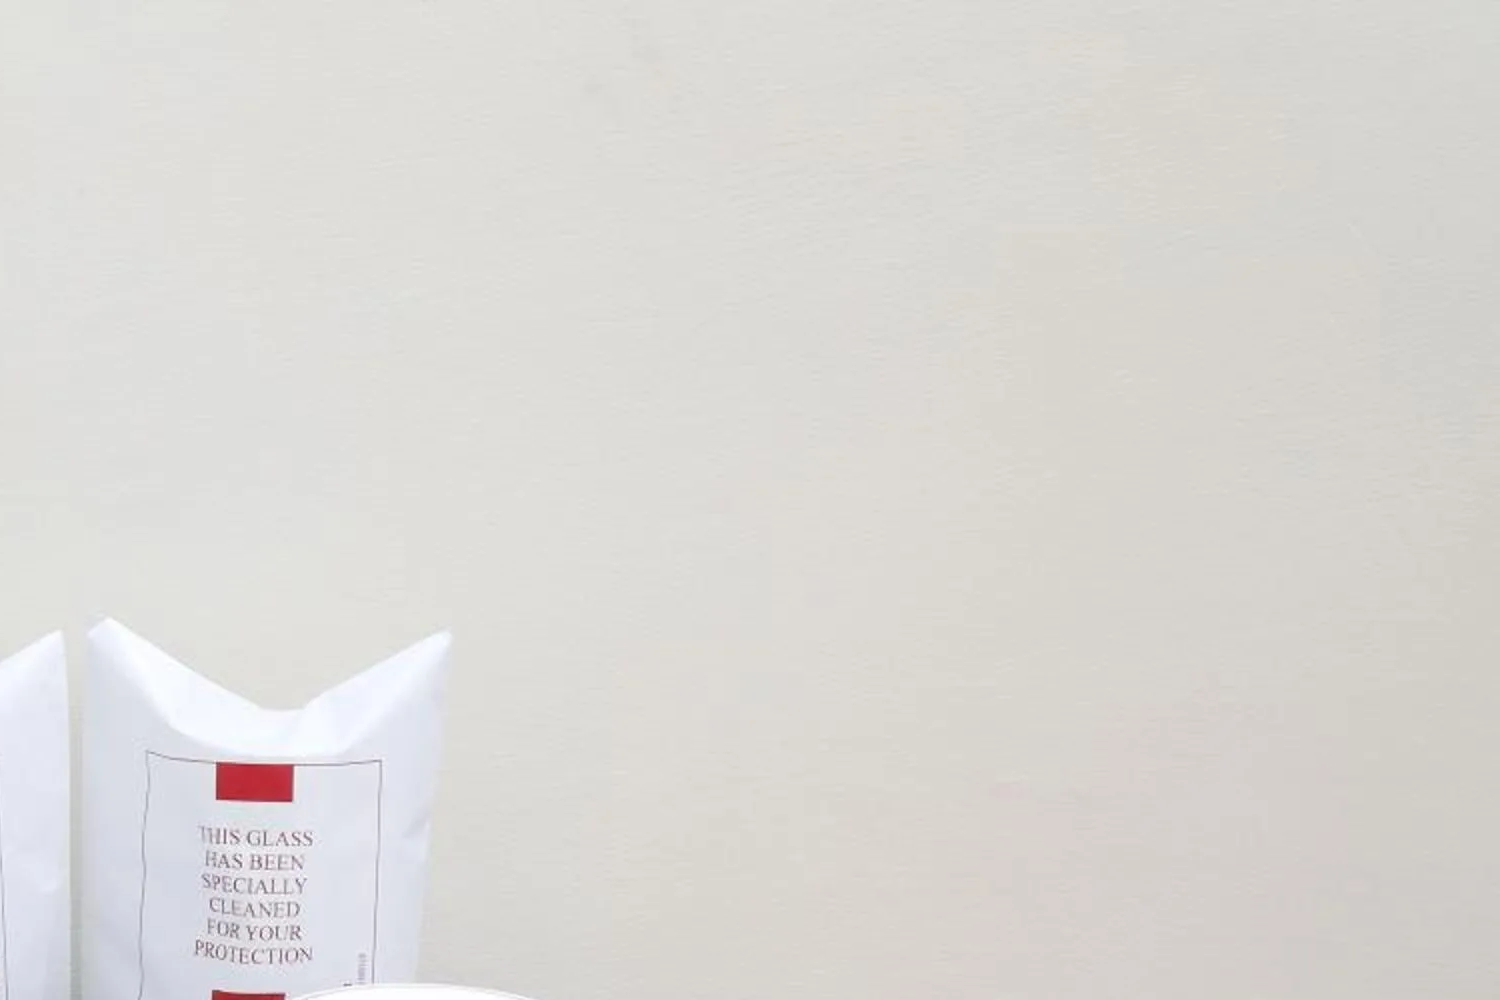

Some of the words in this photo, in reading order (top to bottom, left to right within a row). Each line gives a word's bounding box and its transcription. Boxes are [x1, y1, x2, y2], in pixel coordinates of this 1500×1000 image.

[200, 826, 241, 845] THIS
[246, 830, 314, 847] GLASS
[205, 851, 244, 870] HAS
[250, 853, 305, 871] BEEN
[201, 873, 308, 895] SPECIALLY
[209, 897, 301, 919] CLEANED
[206, 918, 241, 940] FOR
[245, 924, 303, 941] YOUR
[194, 940, 314, 965] PROTECTION
